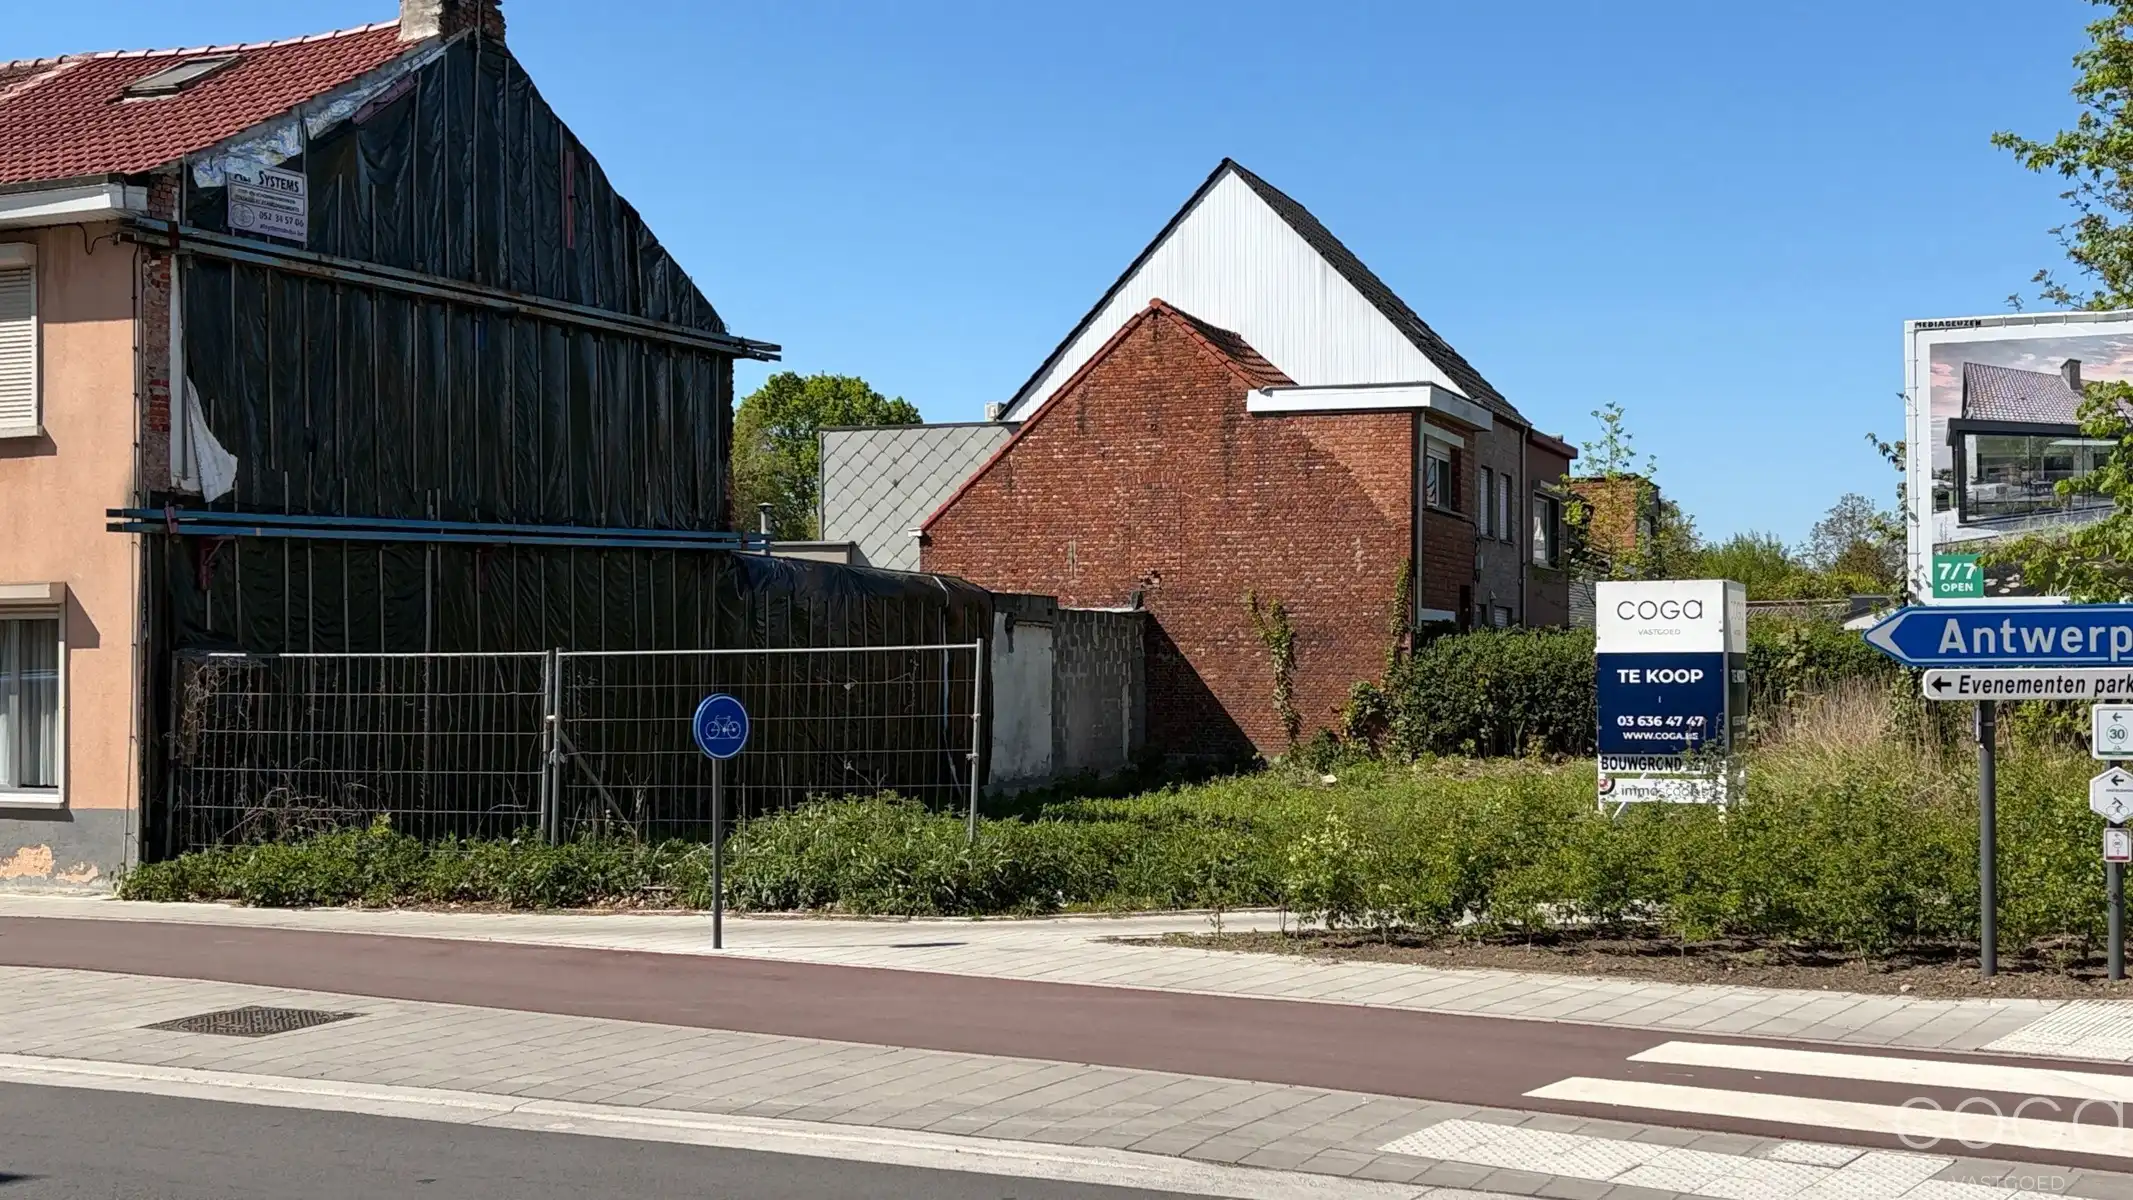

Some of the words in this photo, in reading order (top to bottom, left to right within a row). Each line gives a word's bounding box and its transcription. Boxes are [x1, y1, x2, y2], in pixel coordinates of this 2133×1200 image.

[259, 170, 299, 193] SYSTEMS
[1937, 562, 1977, 580] 7/7
[1940, 582, 1974, 592] OPEN
[1638, 628, 1681, 636] VASTGOED
[1938, 617, 2133, 662] Antwerp
[1616, 669, 1641, 684] TE
[1646, 669, 1704, 684] KOOP
[1958, 674, 2086, 695] Evenementen
[2094, 673, 2133, 698] park
[1616, 715, 1635, 727] 03
[1636, 715, 1663, 727] 636
[1665, 715, 1683, 727] 47
[1686, 715, 1704, 727] 47
[1622, 731, 1700, 741] WWW.COGA.BE
[2109, 728, 2126, 740] 30
[1601, 756, 1682, 772] BOUWGROND
[1620, 784, 1718, 799] immoscoop
